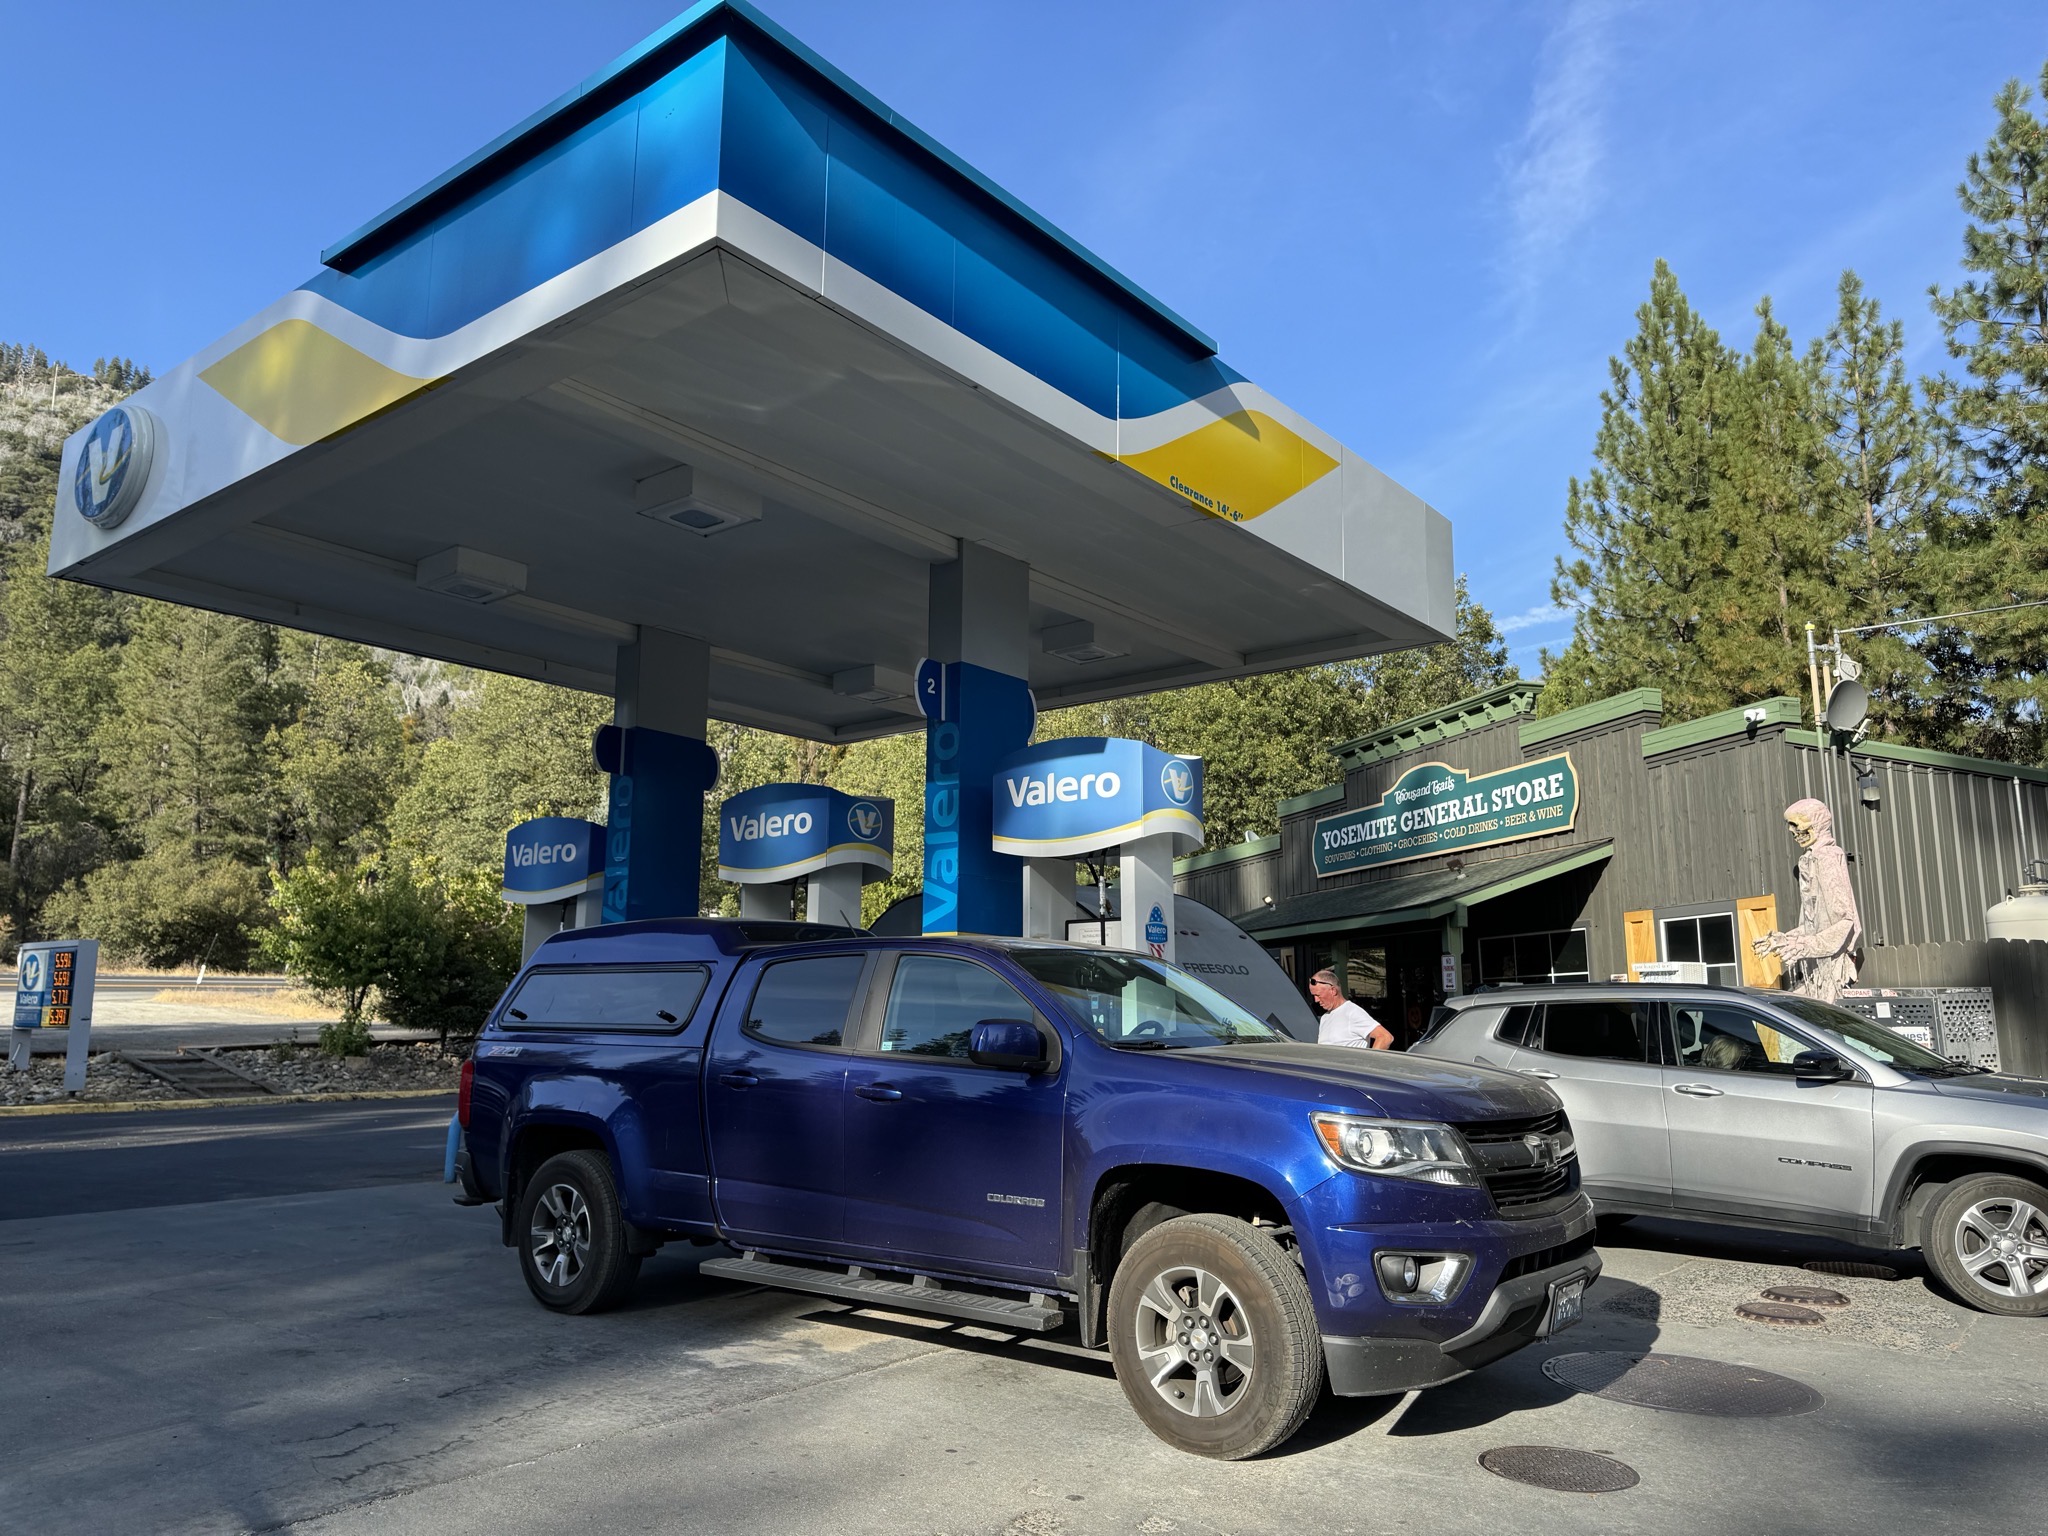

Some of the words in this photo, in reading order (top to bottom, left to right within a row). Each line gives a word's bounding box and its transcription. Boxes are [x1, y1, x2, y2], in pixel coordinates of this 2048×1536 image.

[1170, 475, 1213, 508] Clearance
[927, 678, 936, 695] 2
[1007, 771, 1121, 808] Valero
[1394, 782, 1431, 805] Thousand
[1431, 775, 1455, 796] Trails
[922, 721, 960, 929] Valero
[1322, 815, 1397, 850] YOSEMITE
[1401, 793, 1489, 832] GENERAL
[1491, 772, 1564, 812] STORE
[730, 812, 813, 842] Valero
[1325, 850, 1356, 864] SOUVENIRS
[1360, 841, 1393, 857] CLOTHING
[1398, 832, 1438, 849] GROCERIES
[1443, 826, 1467, 839] COLD
[1468, 819, 1498, 834] DRINKS
[1505, 812, 1528, 827] BEER
[1529, 810, 1536, 821] &
[1536, 804, 1563, 820] WINE
[512, 842, 576, 868] Valero
[1147, 925, 1167, 934] Valero
[1182, 962, 1250, 976] FREESOLO
[19, 993, 38, 1005] Valero
[1778, 1157, 1852, 1171] COMPASS
[987, 1193, 1046, 1208] COLORADO
